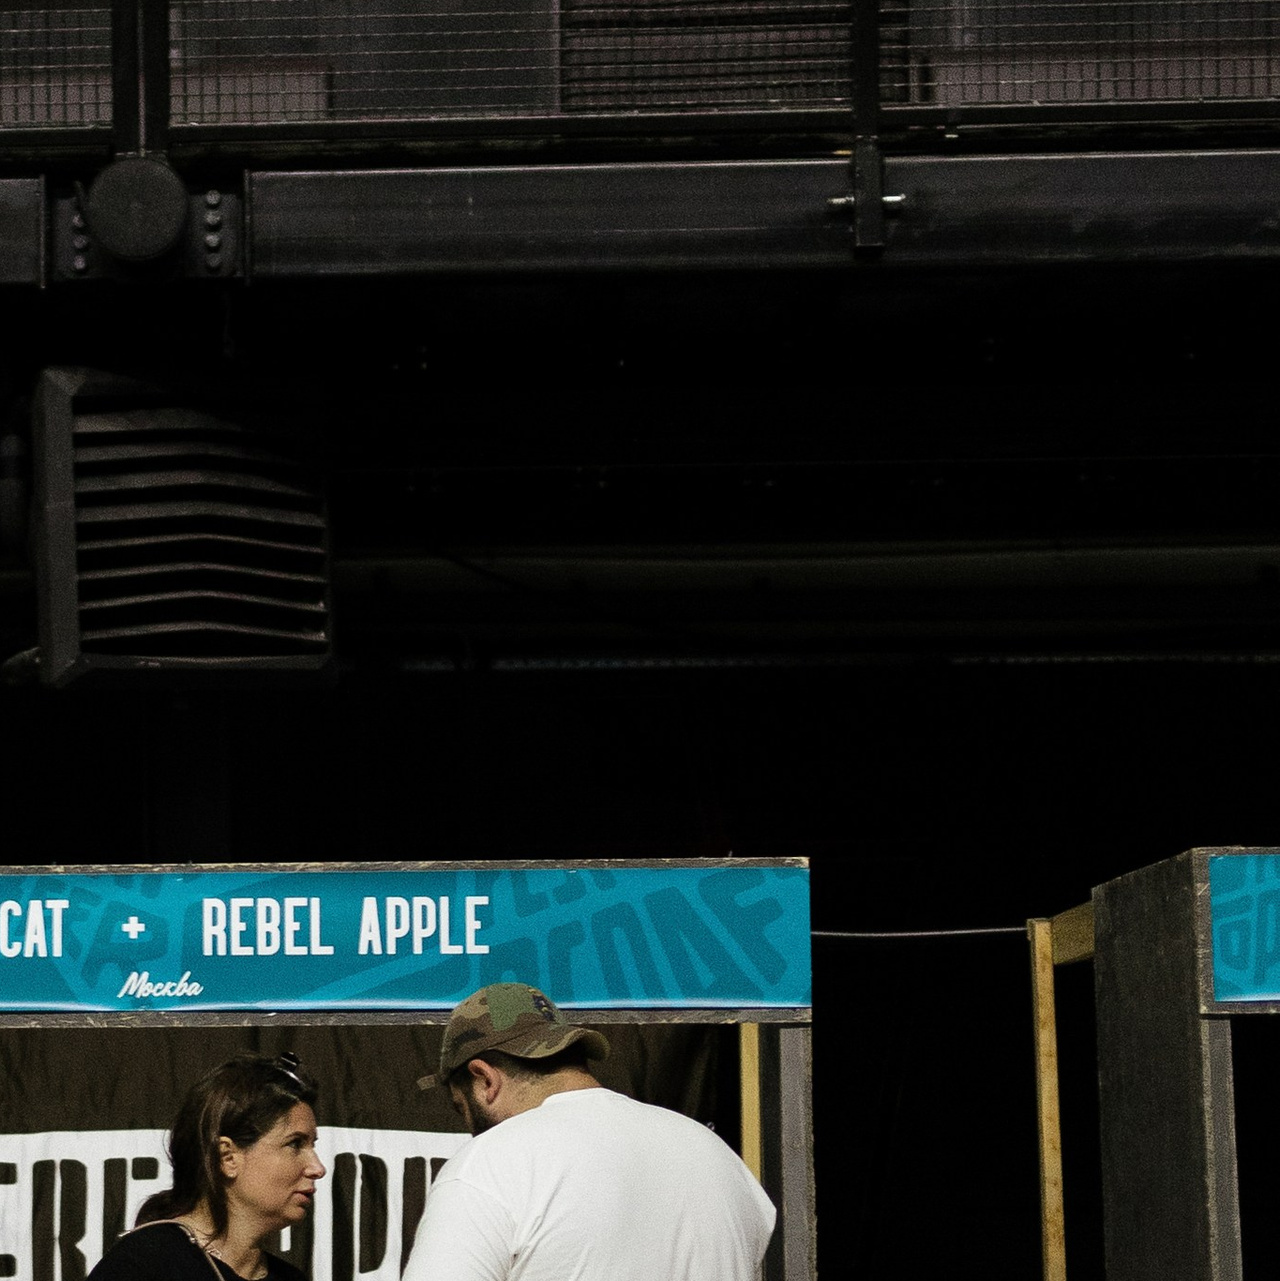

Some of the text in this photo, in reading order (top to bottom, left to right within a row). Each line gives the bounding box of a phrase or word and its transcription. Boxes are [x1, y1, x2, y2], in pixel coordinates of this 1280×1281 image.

[202, 896, 334, 957] REBEL
[357, 895, 490, 956] APPLE
[117, 970, 204, 999] Москва
